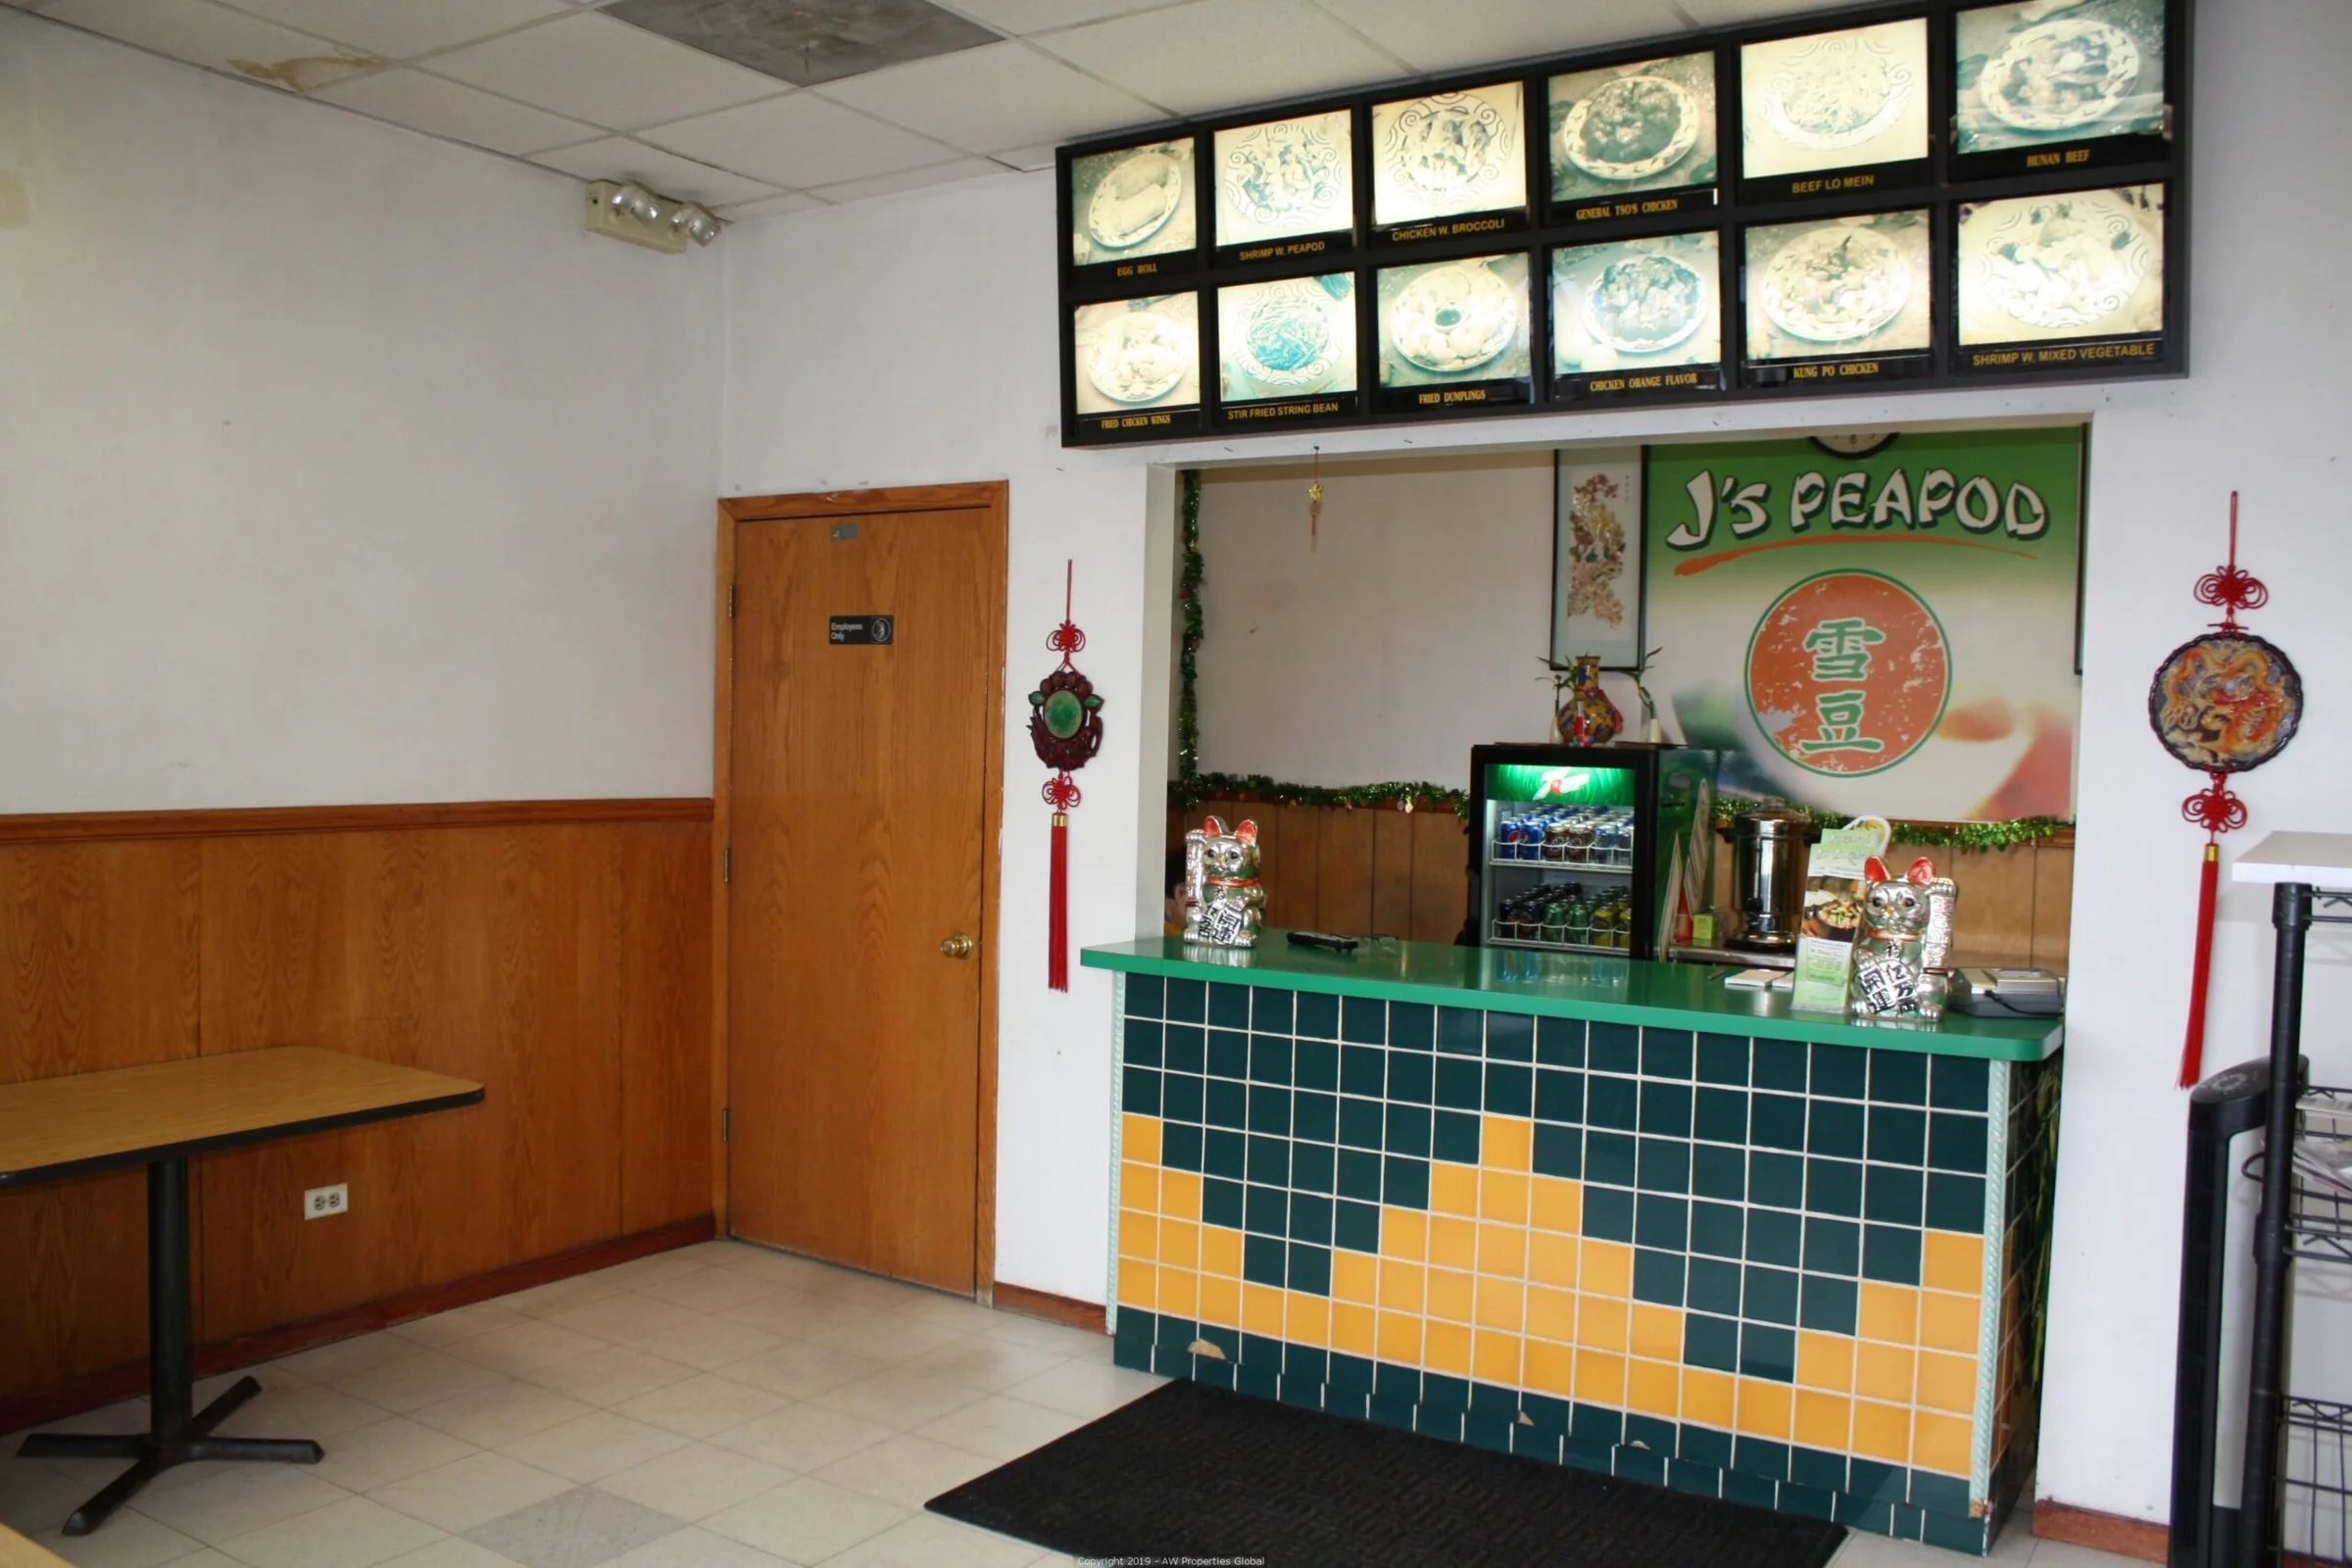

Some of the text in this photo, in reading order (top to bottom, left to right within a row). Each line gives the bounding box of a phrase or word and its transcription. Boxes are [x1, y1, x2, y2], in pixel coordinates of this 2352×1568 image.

[2065, 149, 2090, 164] BEEF
[1791, 174, 1875, 194] BEEF LO MEIN
[1576, 199, 1679, 220] GENERAL TSO'S CHICKEN
[1392, 219, 1505, 241] CHICKEN W. BROCCOLI
[1239, 241, 1325, 261] SHRIMP W. PEAPOD
[1117, 263, 1157, 277] EGG ROLL
[1973, 343, 2155, 367] SHRIMP W. MIXED VEGETABLE
[1793, 362, 1879, 379] KUNG PO CHICKEN
[1590, 372, 1697, 392] CHICKEN ORANGE FLAVOR
[1419, 389, 1486, 405] FRIED DUMPLINGS
[1228, 403, 1339, 420] STIR FRIED STRING BEAN
[1102, 414, 1171, 429] FRIED CHICKEN WINGS
[1789, 467, 2050, 540] PEAPOD
[831, 622, 862, 632] Employees
[831, 632, 845, 641] Only
[1799, 617, 1886, 754] 雪豆
